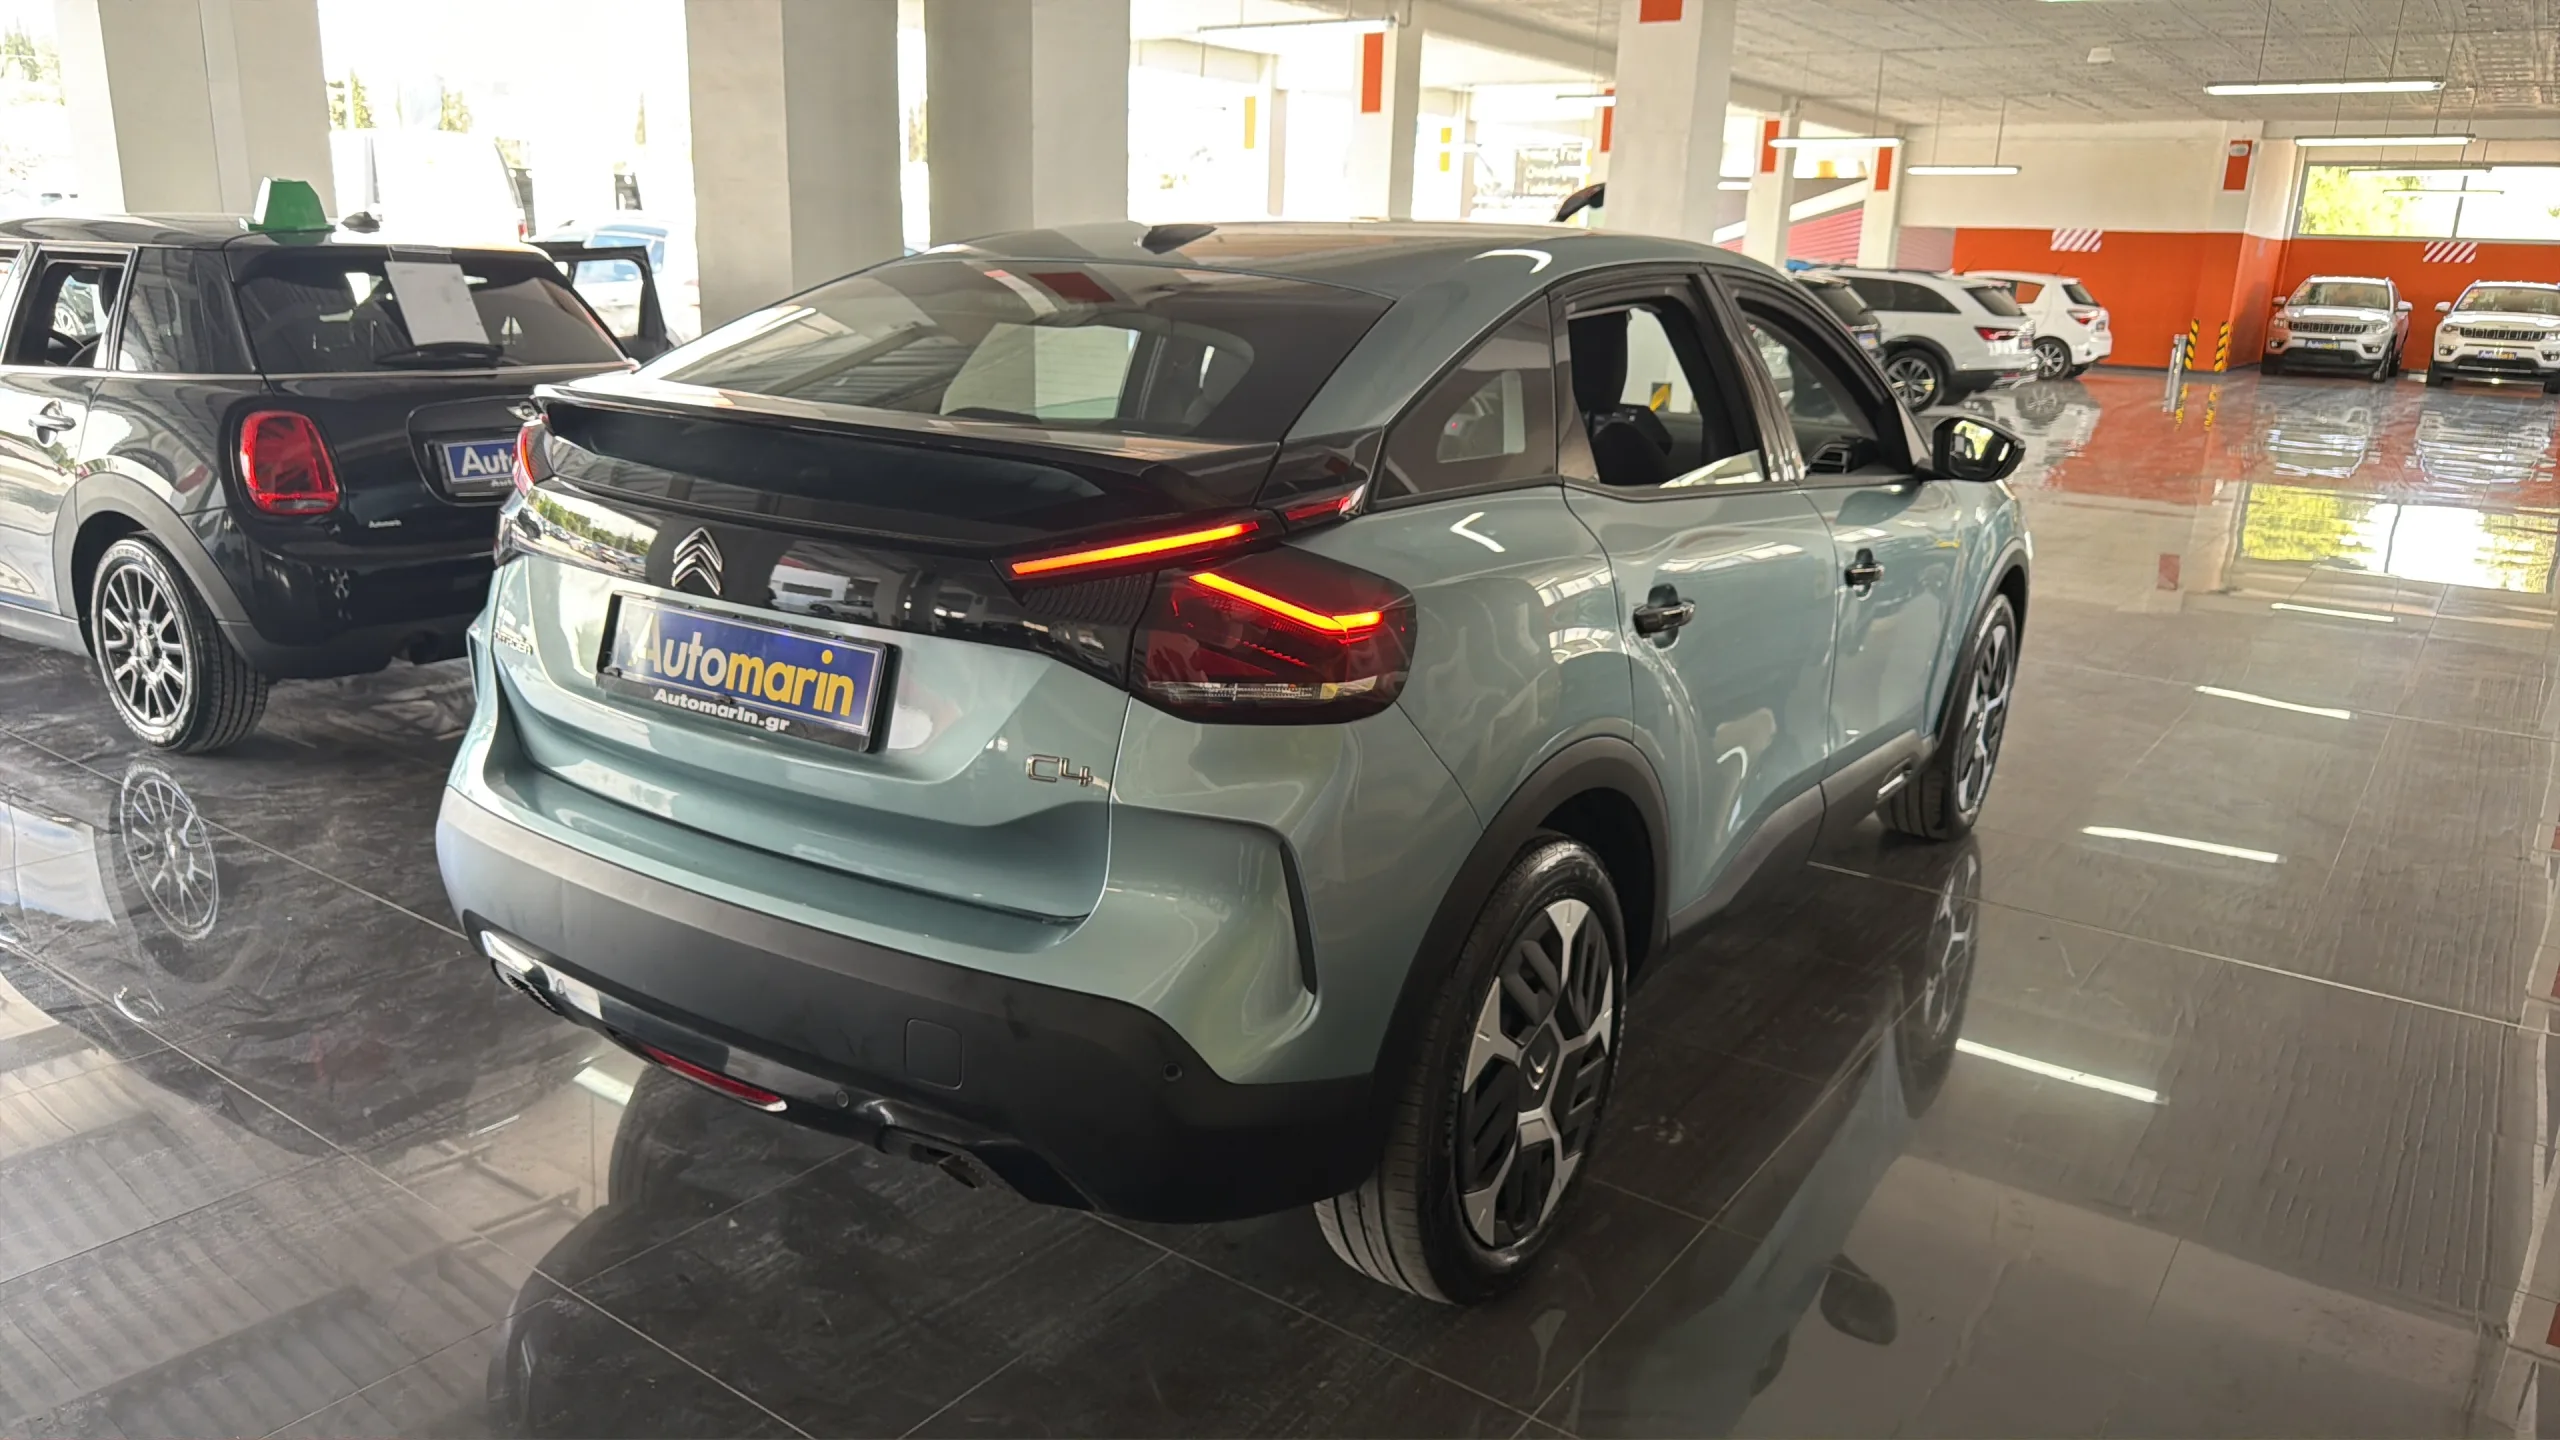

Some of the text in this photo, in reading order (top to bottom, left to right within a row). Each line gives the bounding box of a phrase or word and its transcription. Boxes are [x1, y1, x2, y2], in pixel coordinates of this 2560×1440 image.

[627, 612, 855, 717] Automarin
[653, 687, 791, 733] Automarin.gr
[1025, 753, 1094, 788] C4
